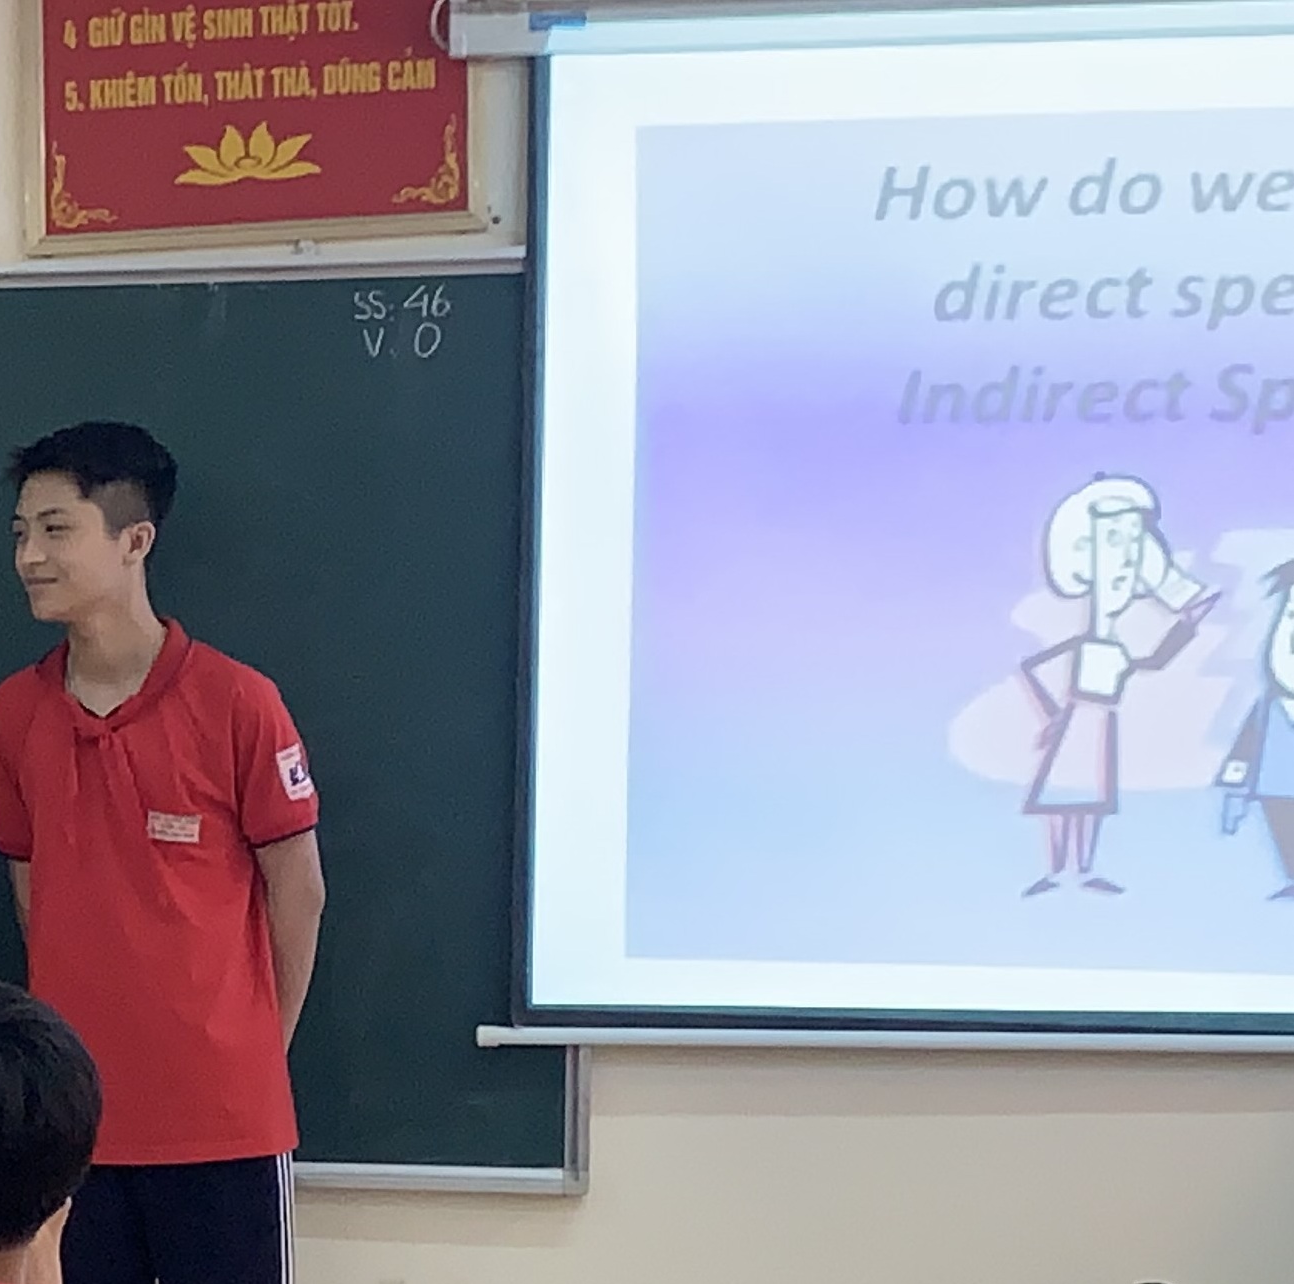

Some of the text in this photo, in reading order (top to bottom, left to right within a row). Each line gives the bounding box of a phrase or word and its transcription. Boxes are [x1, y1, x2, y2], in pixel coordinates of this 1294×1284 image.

[204, 8, 252, 39] SINH
[874, 156, 1294, 221] How do we
[403, 281, 451, 319] 46
[934, 263, 1294, 331] direct spe
[897, 362, 1294, 435] Indirect Sp
